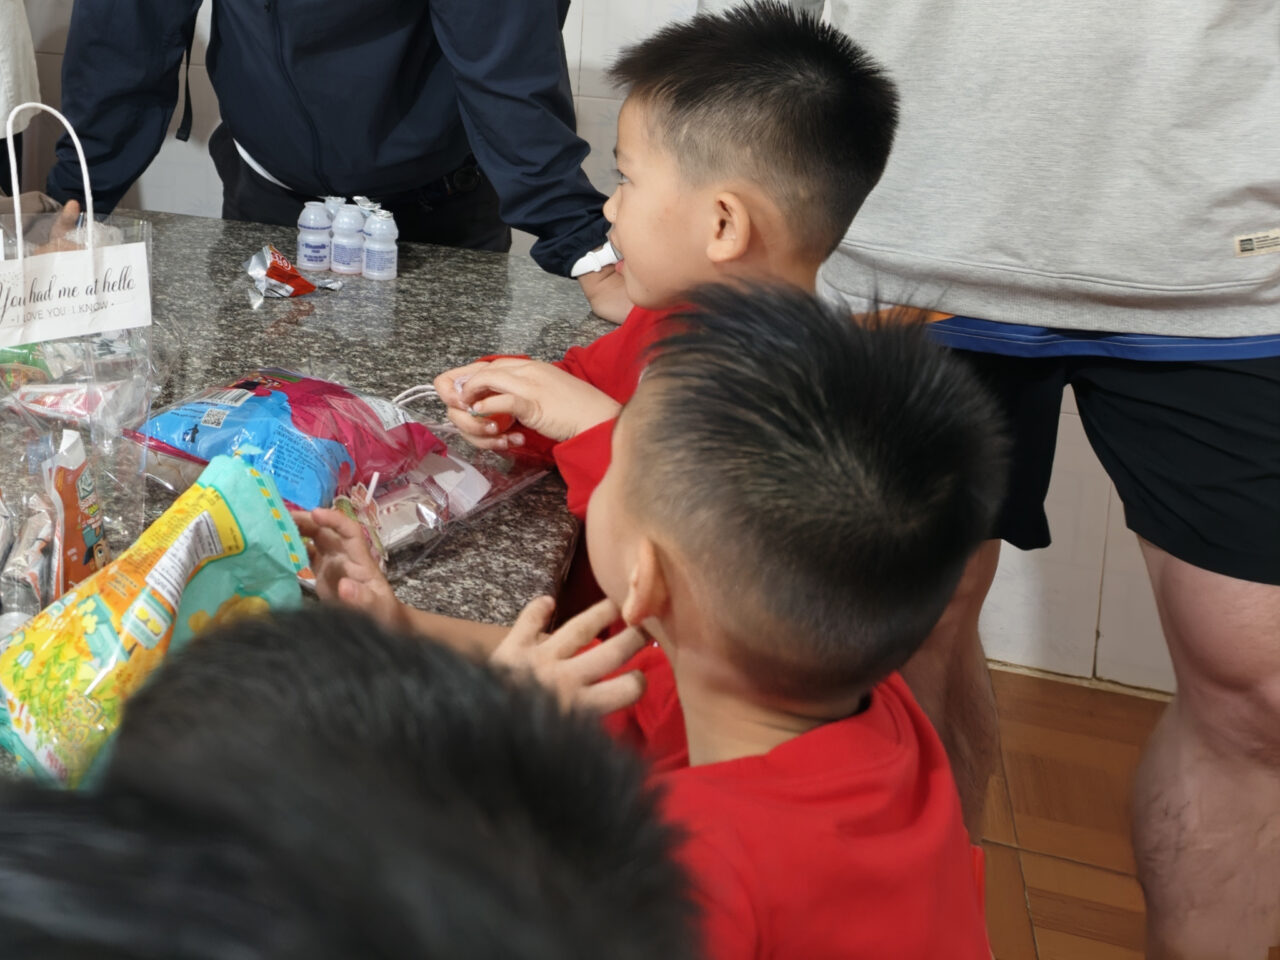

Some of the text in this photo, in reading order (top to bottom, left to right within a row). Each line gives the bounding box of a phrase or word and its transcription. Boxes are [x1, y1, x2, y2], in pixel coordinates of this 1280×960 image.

[28, 275, 57, 303] had
[58, 287, 81, 299] me
[85, 278, 99, 297] at
[100, 265, 137, 295] hello
[22, 310, 45, 324] LOVE
[47, 306, 67, 318] YOU
